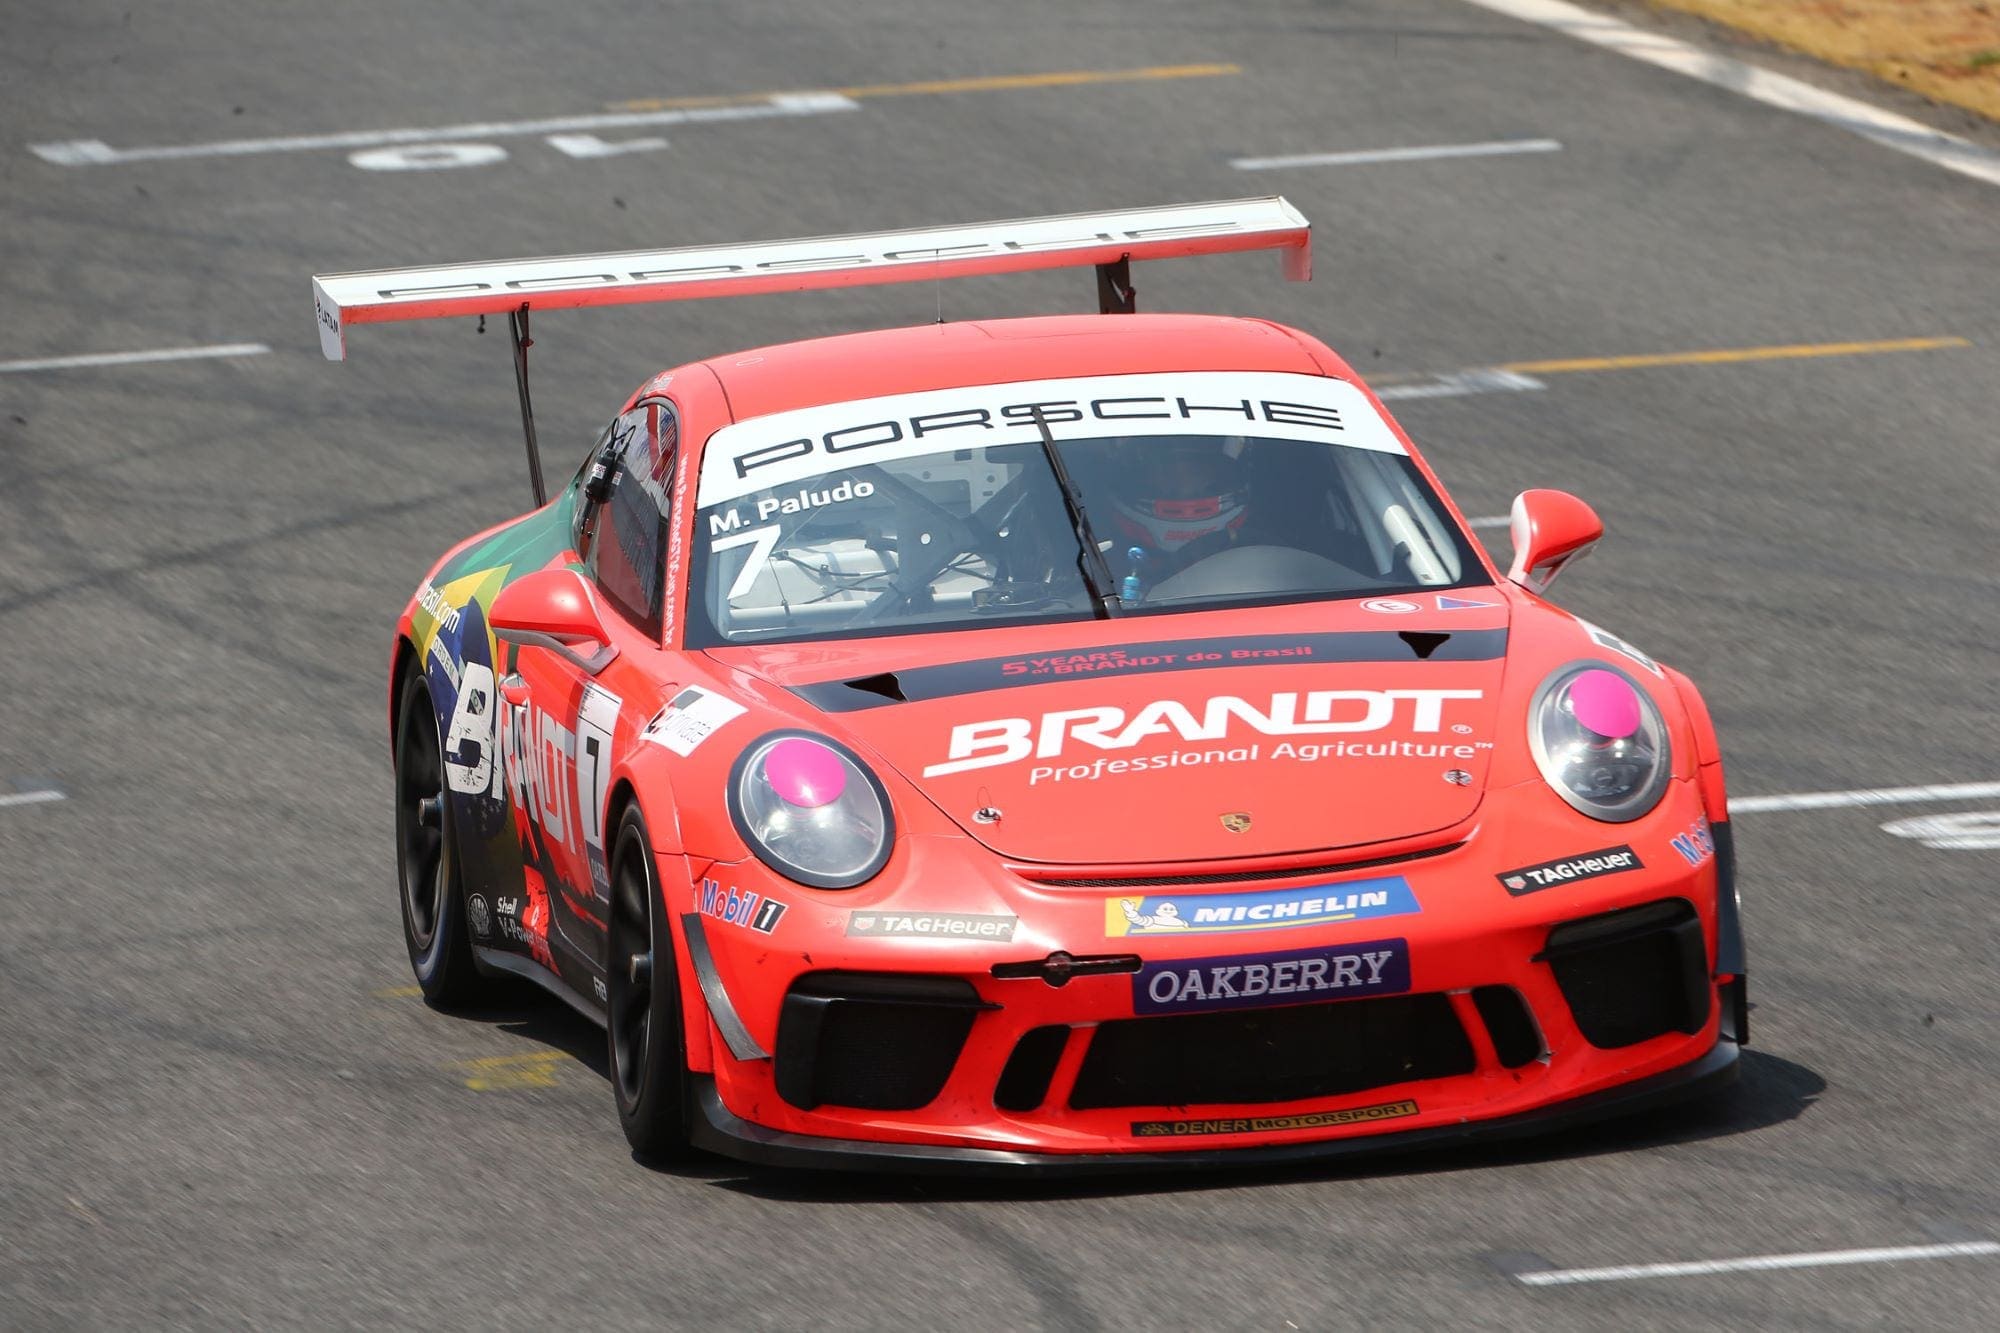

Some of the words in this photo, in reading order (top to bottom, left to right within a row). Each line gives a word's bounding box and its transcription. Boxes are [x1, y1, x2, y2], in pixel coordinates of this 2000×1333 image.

[733, 397, 1344, 479] PORSCHE
[709, 510, 751, 535] M.
[758, 477, 875, 518] Paludo
[711, 525, 782, 600] 7
[1002, 661, 1029, 676] 5
[1030, 650, 1128, 668] YEARS
[1053, 654, 1177, 675] BRANDT
[1186, 652, 1222, 662] do
[1231, 646, 1313, 660] Brasil
[586, 735, 600, 838] 7
[1029, 743, 1259, 785] Professional
[496, 896, 518, 915] Shell
[701, 877, 759, 928] Mobil
[1194, 889, 1389, 923] MICHELIN
[1148, 950, 1394, 1004] OAKBERRY
[1173, 1119, 1249, 1135] DENER
[1256, 1102, 1413, 1130] MOTORSPORT
